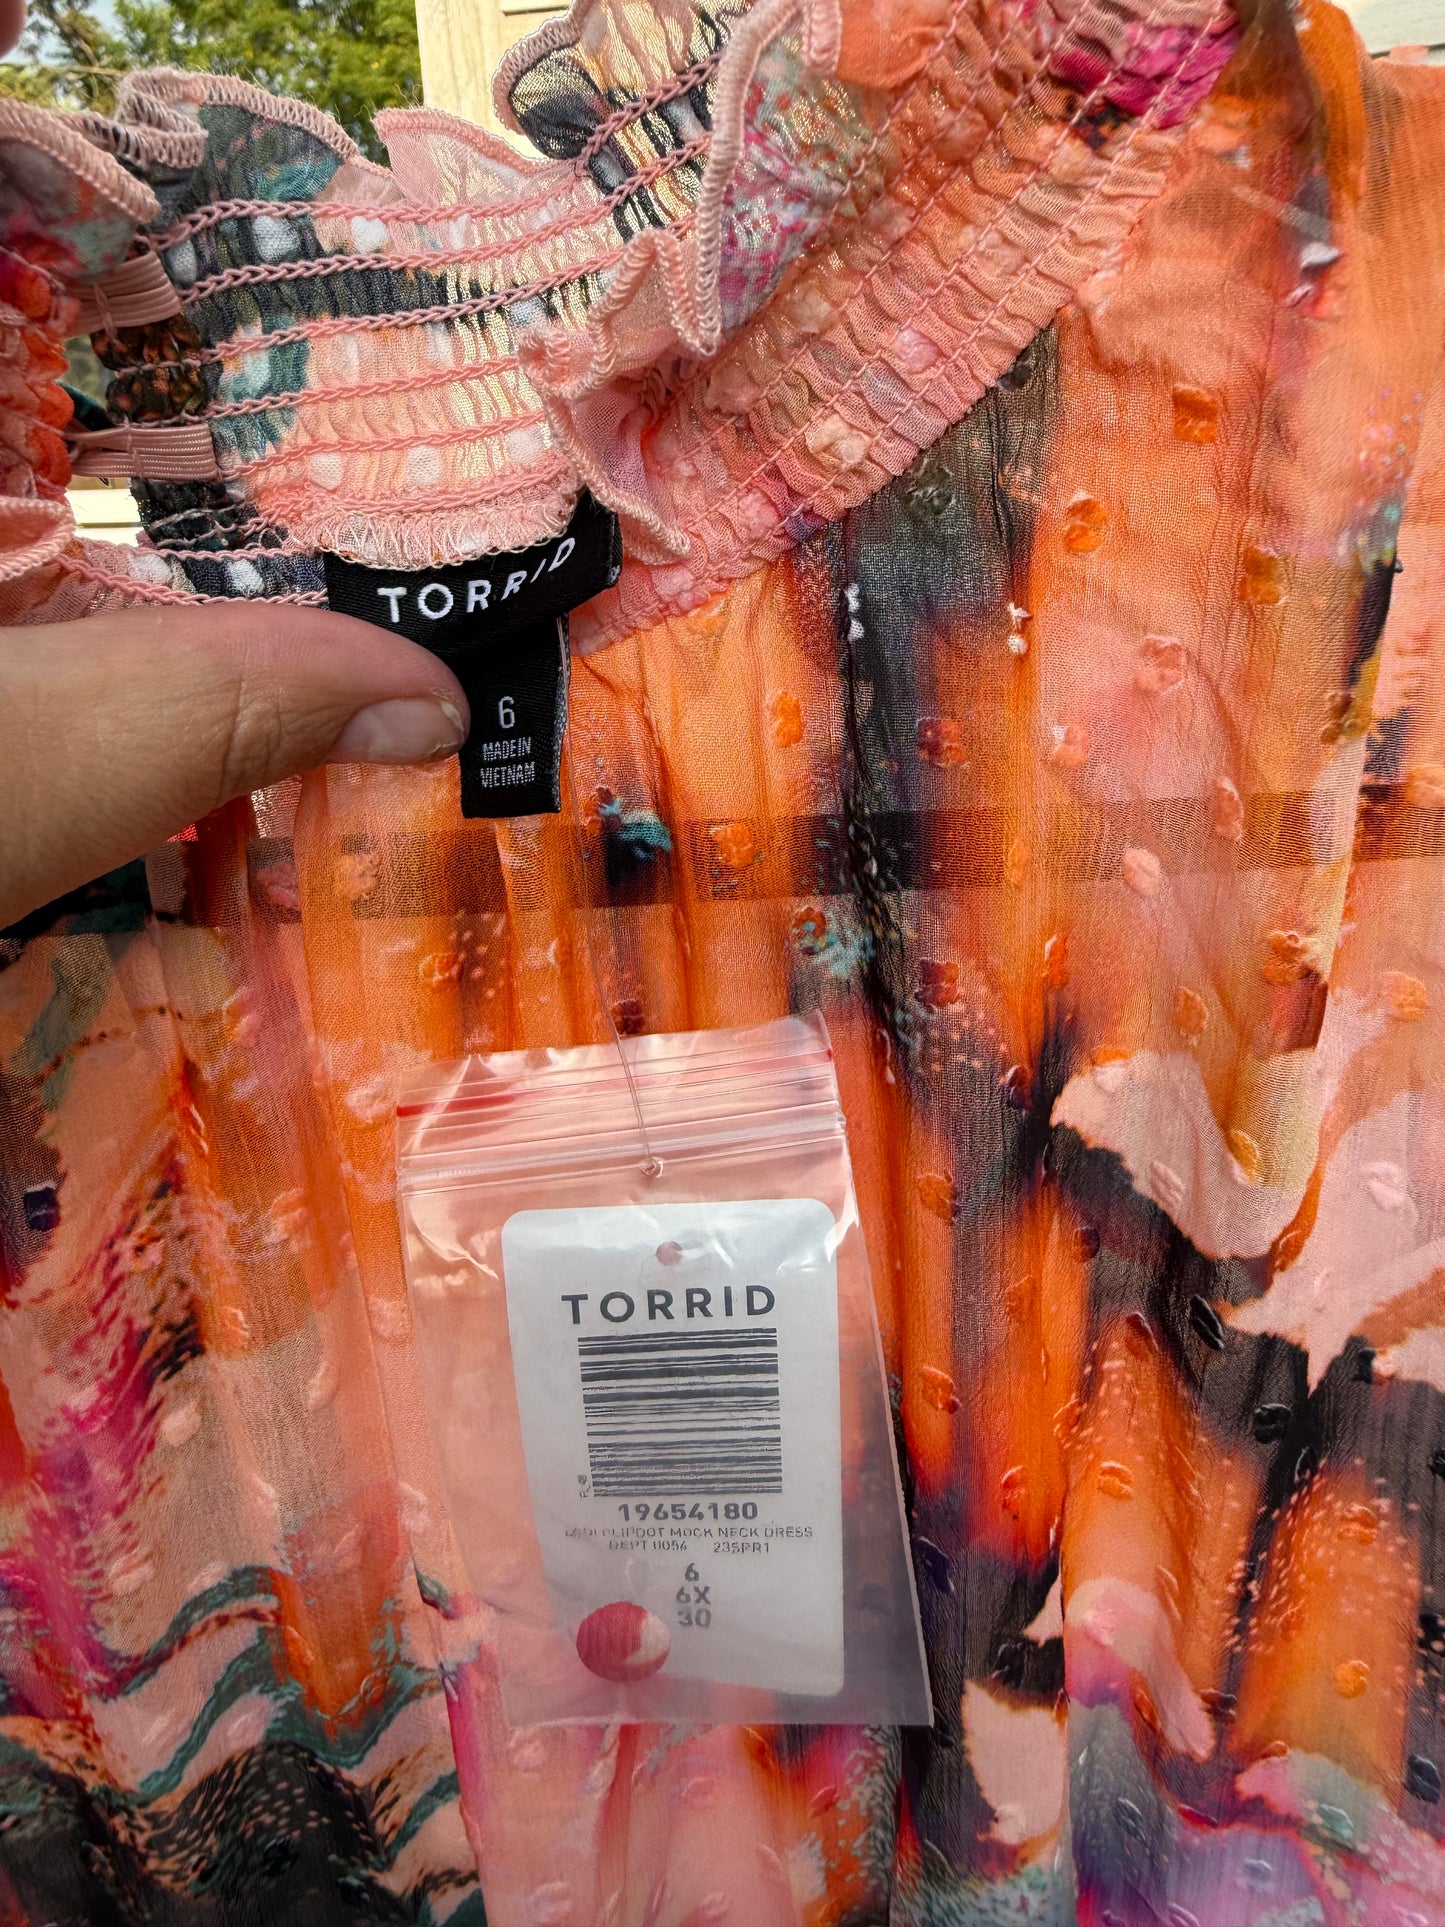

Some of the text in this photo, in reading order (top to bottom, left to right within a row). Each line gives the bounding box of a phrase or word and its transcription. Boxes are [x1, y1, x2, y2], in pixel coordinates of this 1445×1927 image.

[377, 537, 576, 623] TORRID
[498, 696, 516, 729] 6
[482, 740, 516, 761] MADE
[480, 762, 536, 788] VIETNAM
[561, 1285, 776, 1325] TORRID
[618, 1502, 758, 1522] 19654180
[670, 1527, 713, 1538] MOCK
[718, 1527, 759, 1538] NECK
[764, 1526, 813, 1538] DRESS
[608, 1541, 647, 1551] DEPT
[685, 1562, 700, 1582] 6
[676, 1586, 711, 1605] 6X
